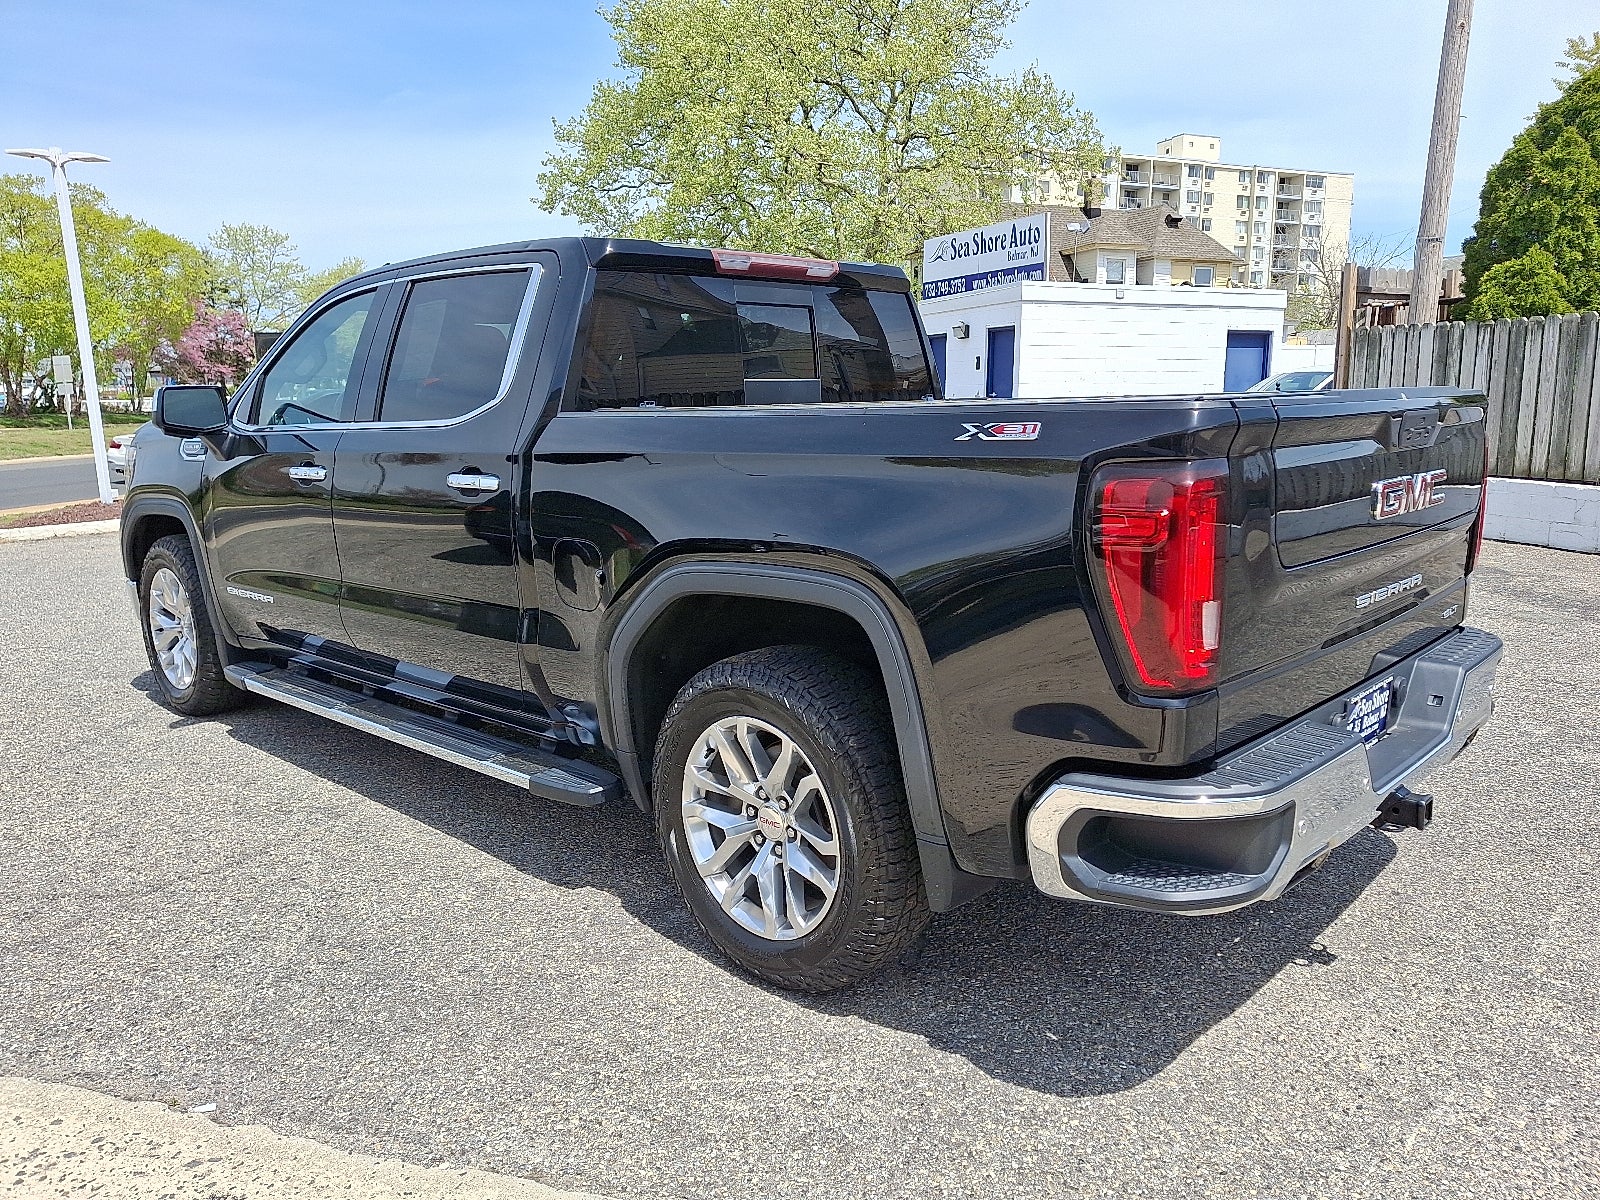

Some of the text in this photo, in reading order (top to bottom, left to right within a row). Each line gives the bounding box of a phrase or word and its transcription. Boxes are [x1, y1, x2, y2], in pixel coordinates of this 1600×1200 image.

[950, 223, 1040, 260] Sea Shore Auto
[1030, 245, 1039, 257] NJ
[1371, 469, 1447, 520] GMC
[226, 586, 274, 603] SIERRA
[1355, 574, 1423, 608] SIERRA
[1360, 690, 1389, 717] Sea Shore
[760, 816, 780, 829] GMC
